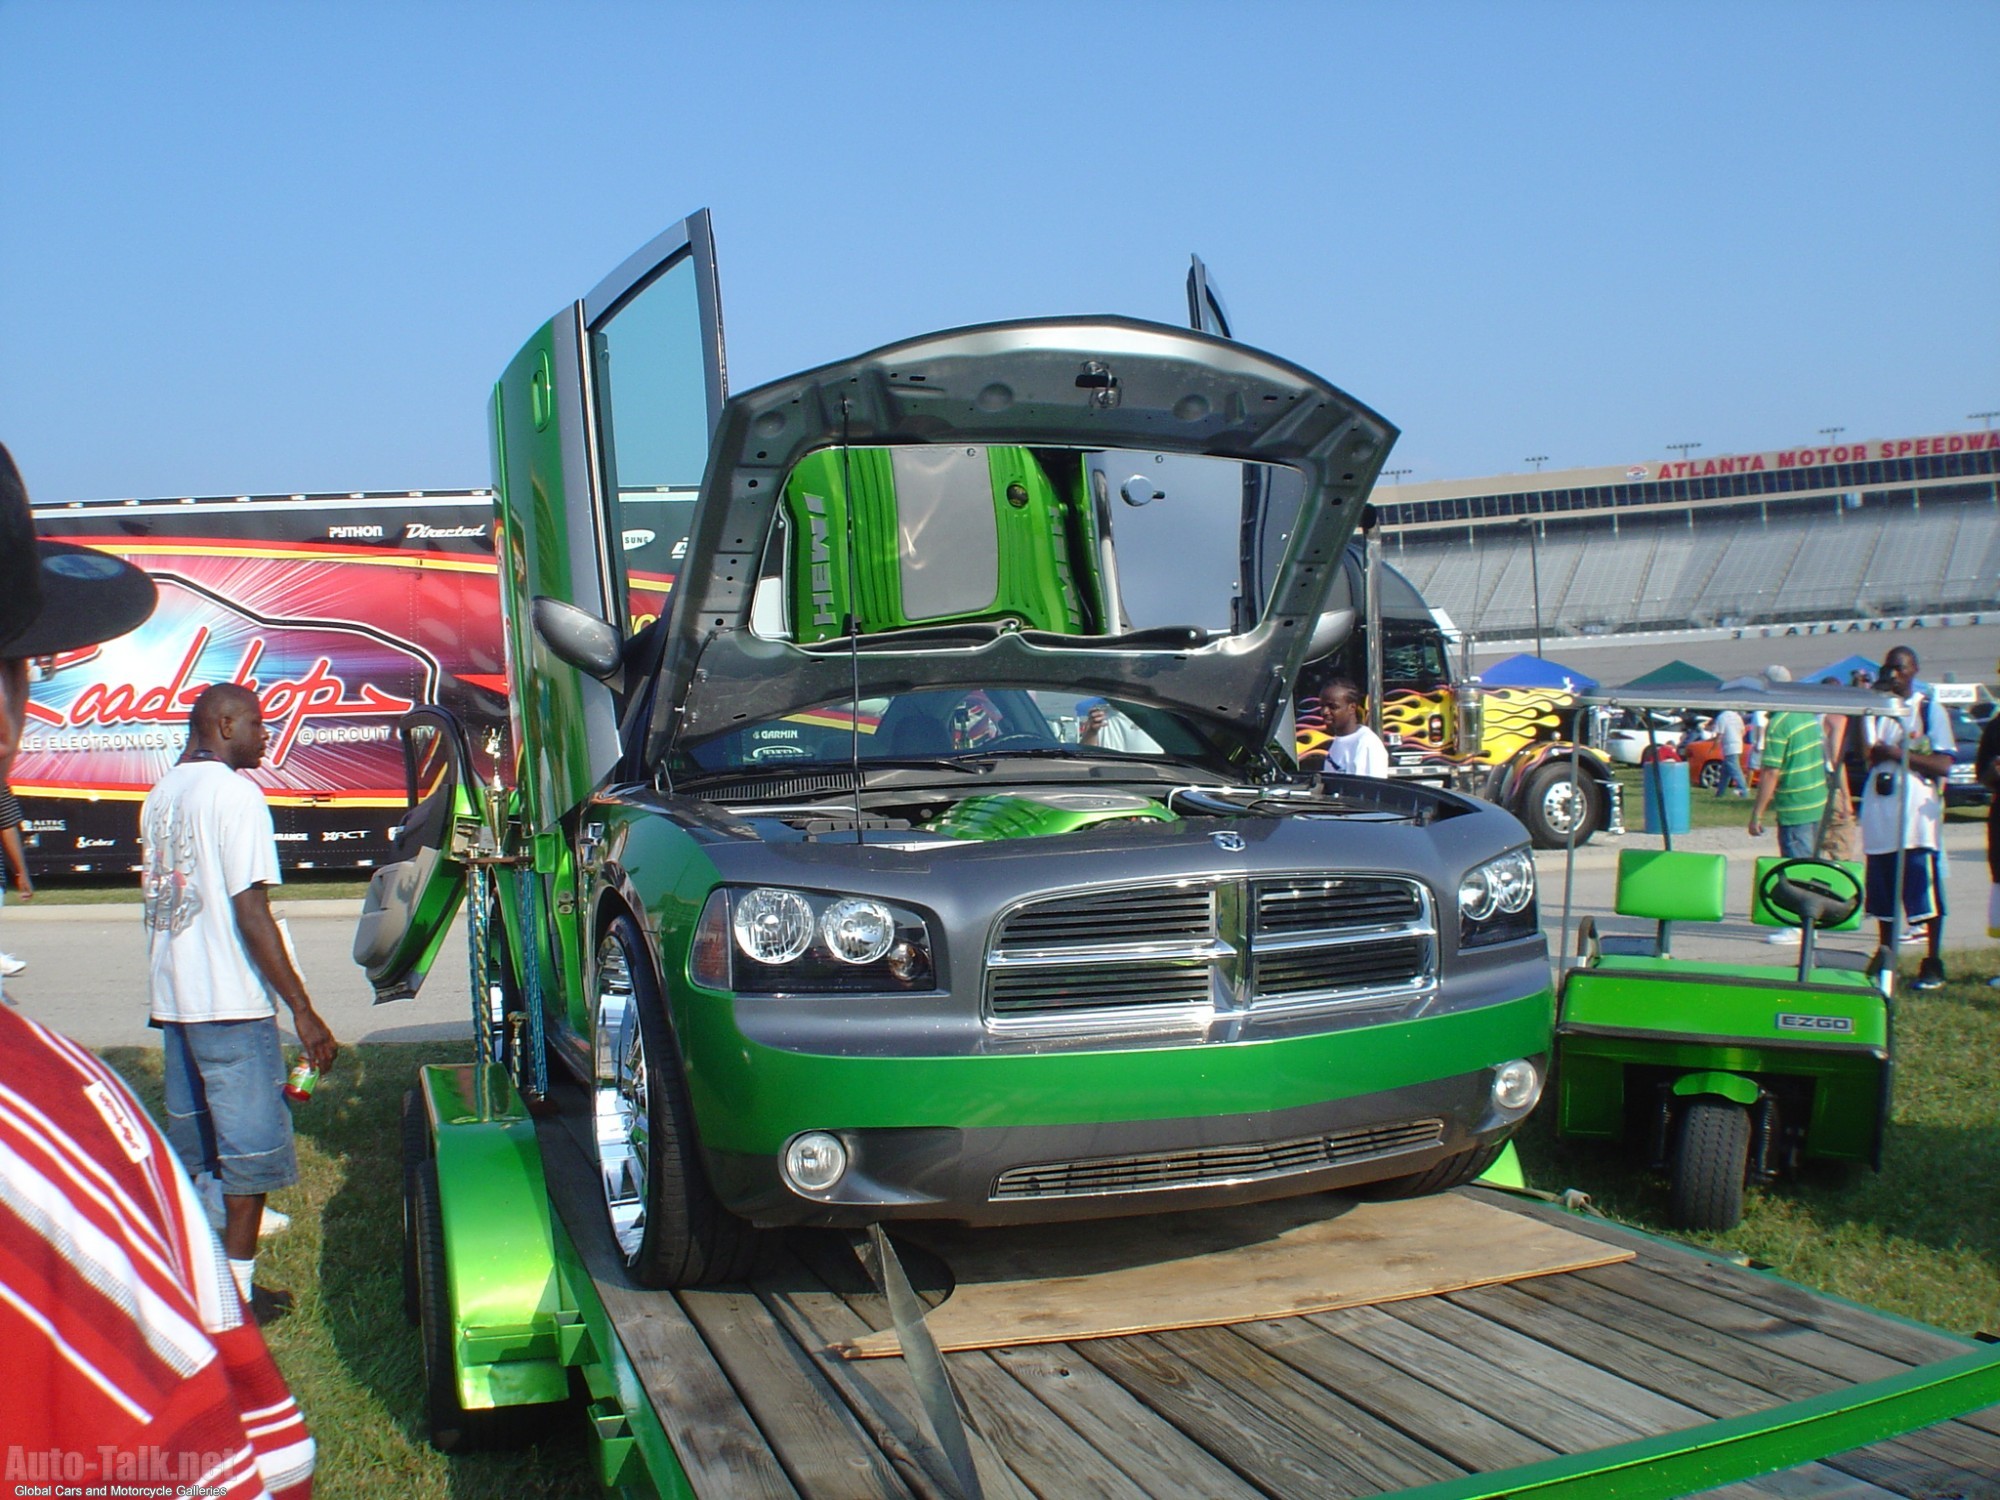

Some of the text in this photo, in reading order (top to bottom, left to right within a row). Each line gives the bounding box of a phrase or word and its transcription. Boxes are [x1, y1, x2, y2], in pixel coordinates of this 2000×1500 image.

[1657, 430, 2000, 479] ATLANTA MOTOR SPEEDWA
[329, 525, 383, 538] PYTHON
[405, 523, 487, 539] Directed
[1784, 617, 1924, 637] ATLANTA
[49, 733, 165, 750] ELECTRONICS
[761, 729, 799, 740] GARMIN
